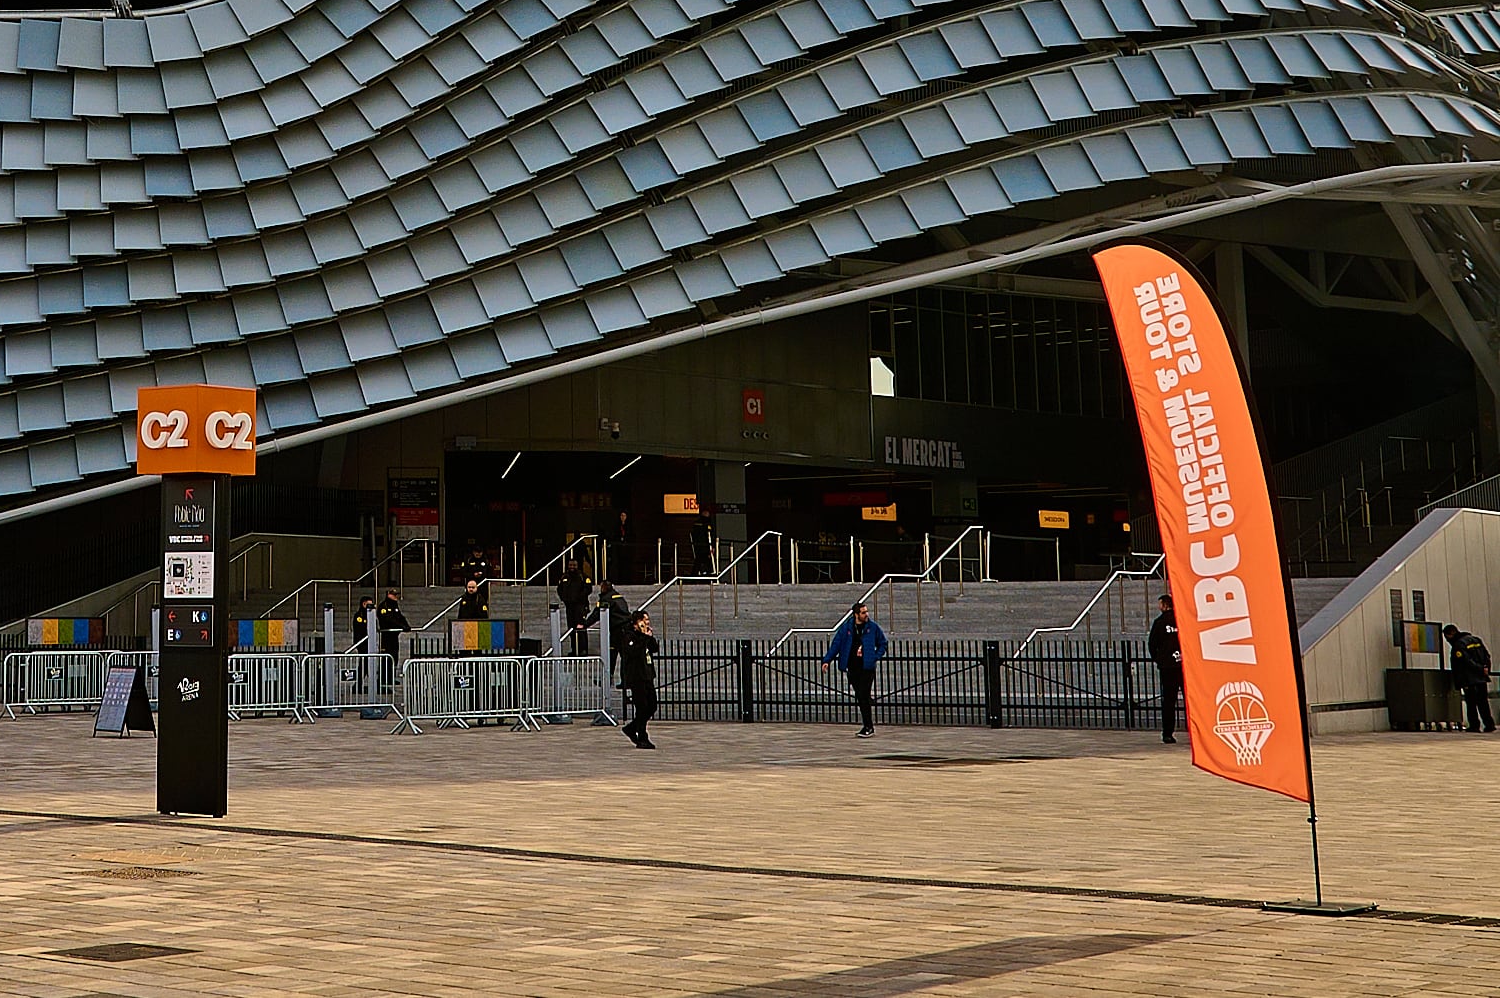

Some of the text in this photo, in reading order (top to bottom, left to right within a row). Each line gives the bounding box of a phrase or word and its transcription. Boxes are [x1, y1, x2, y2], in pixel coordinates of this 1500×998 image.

[746, 396, 762, 415] C1
[140, 410, 189, 449] C2
[205, 410, 253, 450] C2
[884, 436, 900, 465] EL
[902, 438, 951, 468] MERCAT
[192, 610, 200, 623] K
[167, 629, 174, 641] E
